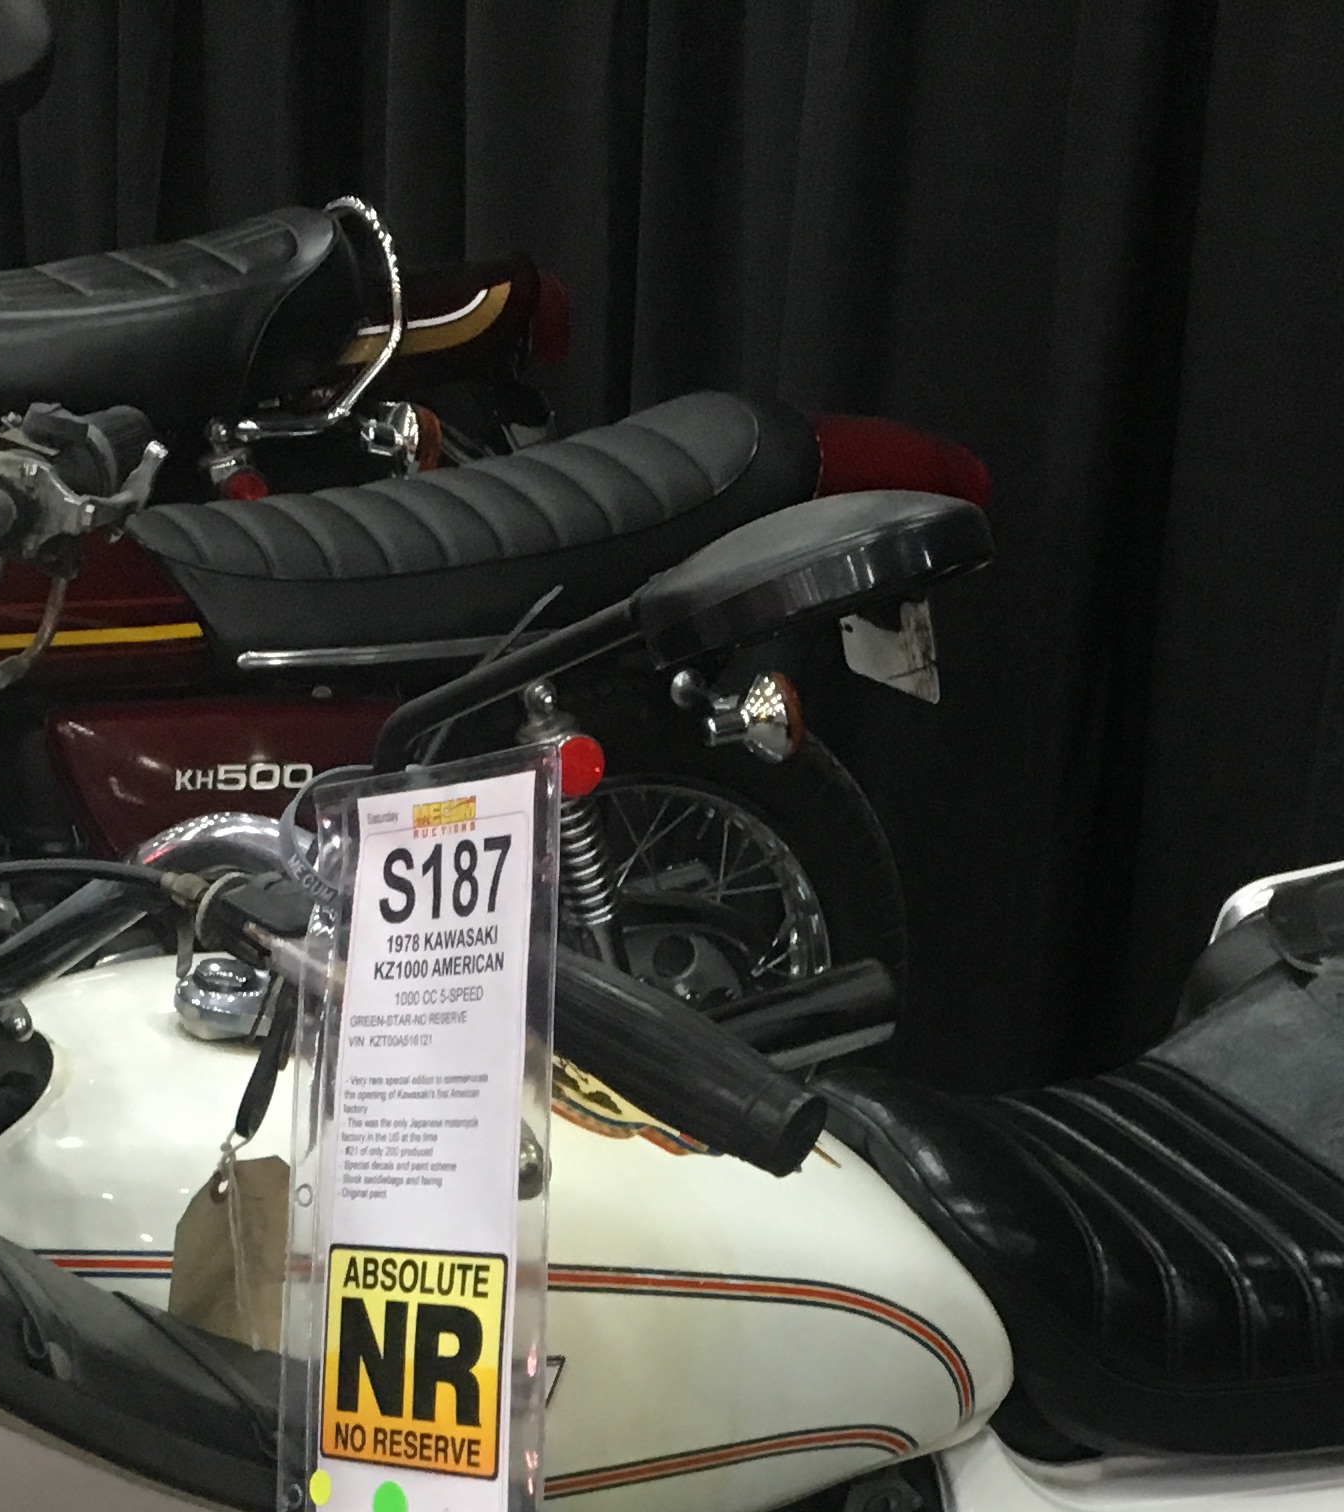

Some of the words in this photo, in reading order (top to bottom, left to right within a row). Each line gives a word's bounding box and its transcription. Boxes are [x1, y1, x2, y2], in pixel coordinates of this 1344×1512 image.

[174, 763, 314, 791] KH500
[287, 853, 339, 902] MECUM
[378, 834, 512, 924] S187
[387, 933, 420, 953] 1978
[424, 925, 498, 951] KAWASAKI
[374, 961, 428, 980] KZ1000
[432, 951, 504, 978] AMERICAN
[394, 991, 419, 1006] 1000
[422, 990, 436, 1005] CC
[440, 985, 484, 1004] 5-SPEED
[429, 1010, 467, 1024] RESERVE
[343, 1257, 490, 1298] ABSOLUTE
[336, 1296, 483, 1428] NR
[334, 1422, 366, 1452] NO
[373, 1429, 481, 1468] RESERVE
